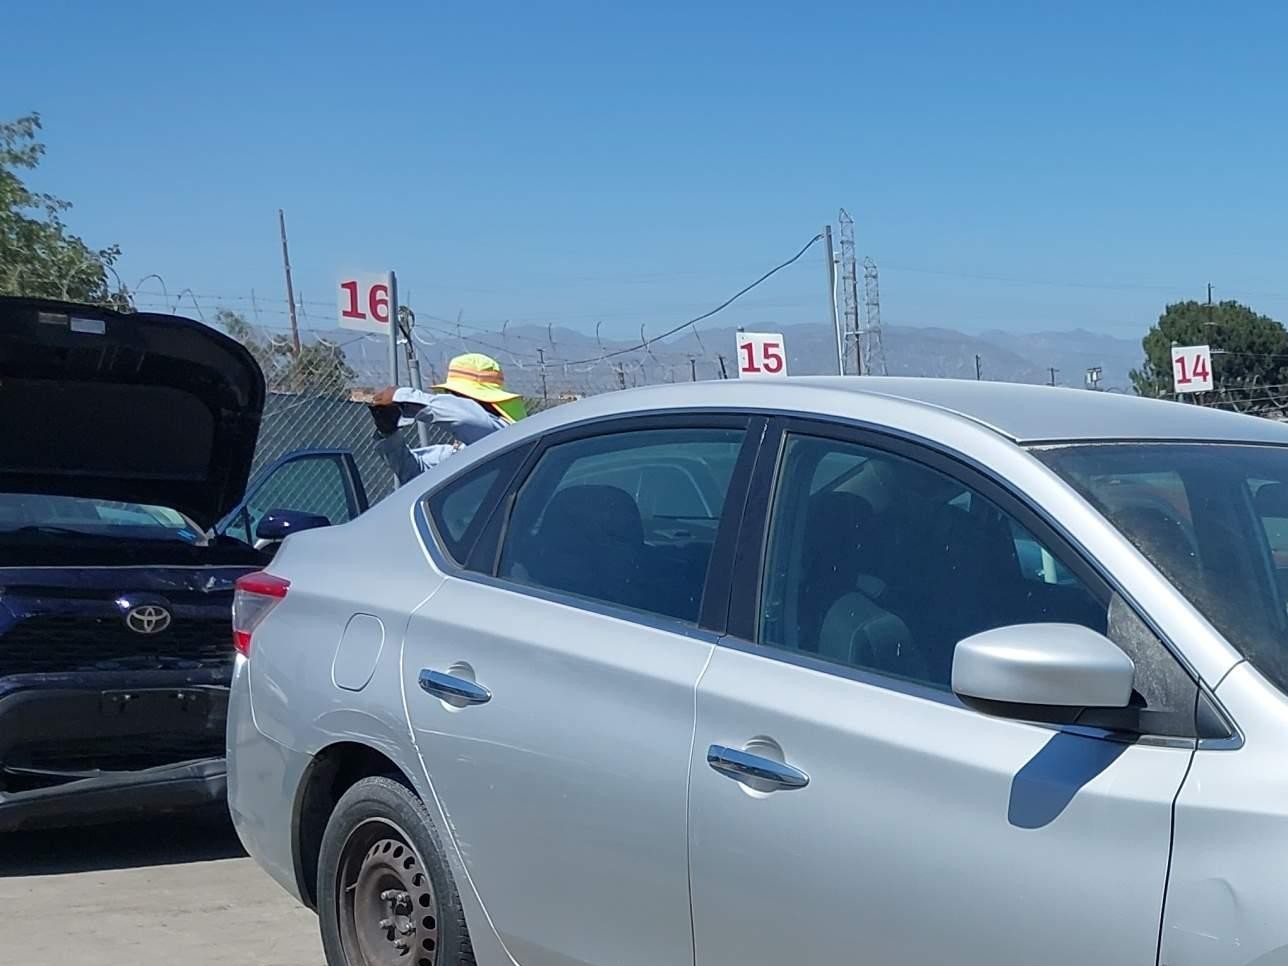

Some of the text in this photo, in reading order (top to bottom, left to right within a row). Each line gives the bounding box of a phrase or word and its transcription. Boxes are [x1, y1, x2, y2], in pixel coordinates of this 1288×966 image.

[341, 281, 389, 323] 16
[740, 342, 783, 373] 15
[1175, 354, 1209, 384] 14
